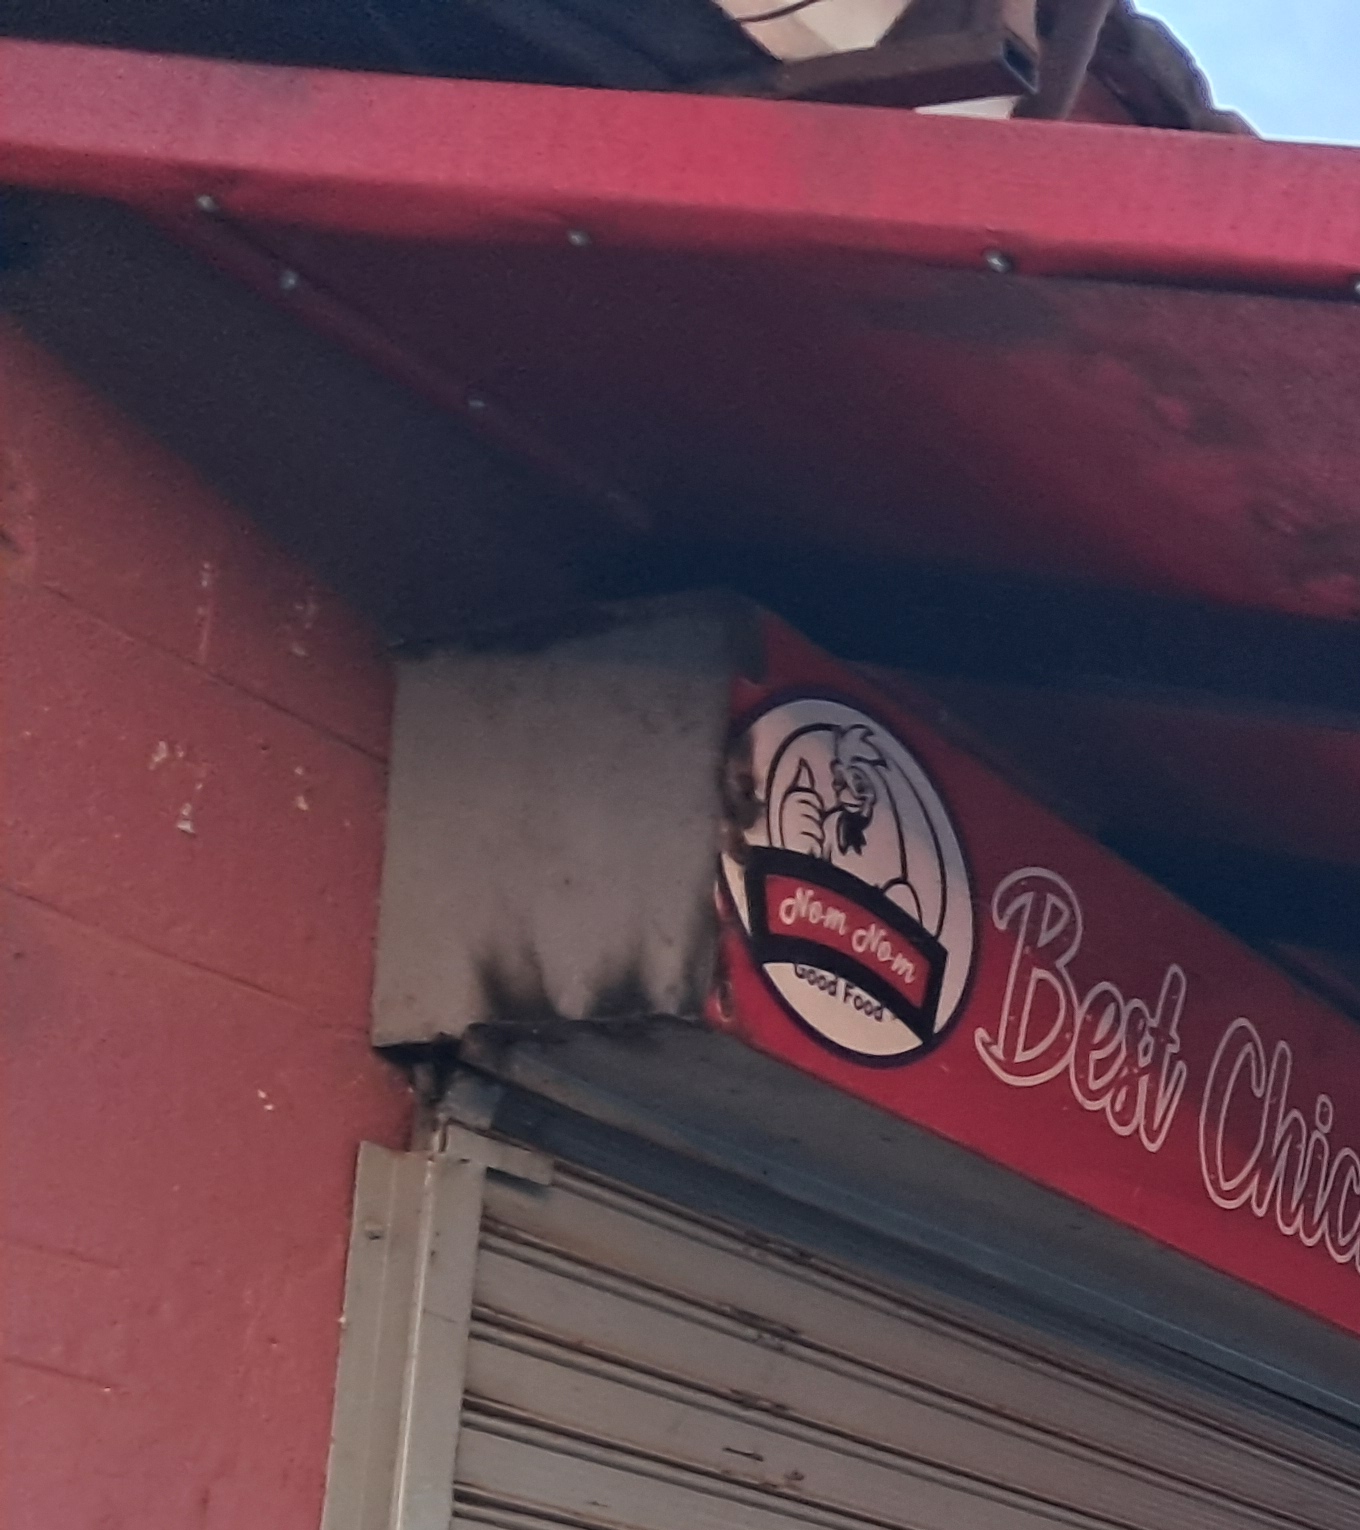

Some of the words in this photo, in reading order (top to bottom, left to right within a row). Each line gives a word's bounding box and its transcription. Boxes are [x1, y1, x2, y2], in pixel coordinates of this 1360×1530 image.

[779, 887, 847, 936] Nom
[852, 923, 916, 984] Nom
[974, 866, 1187, 1153] Best
